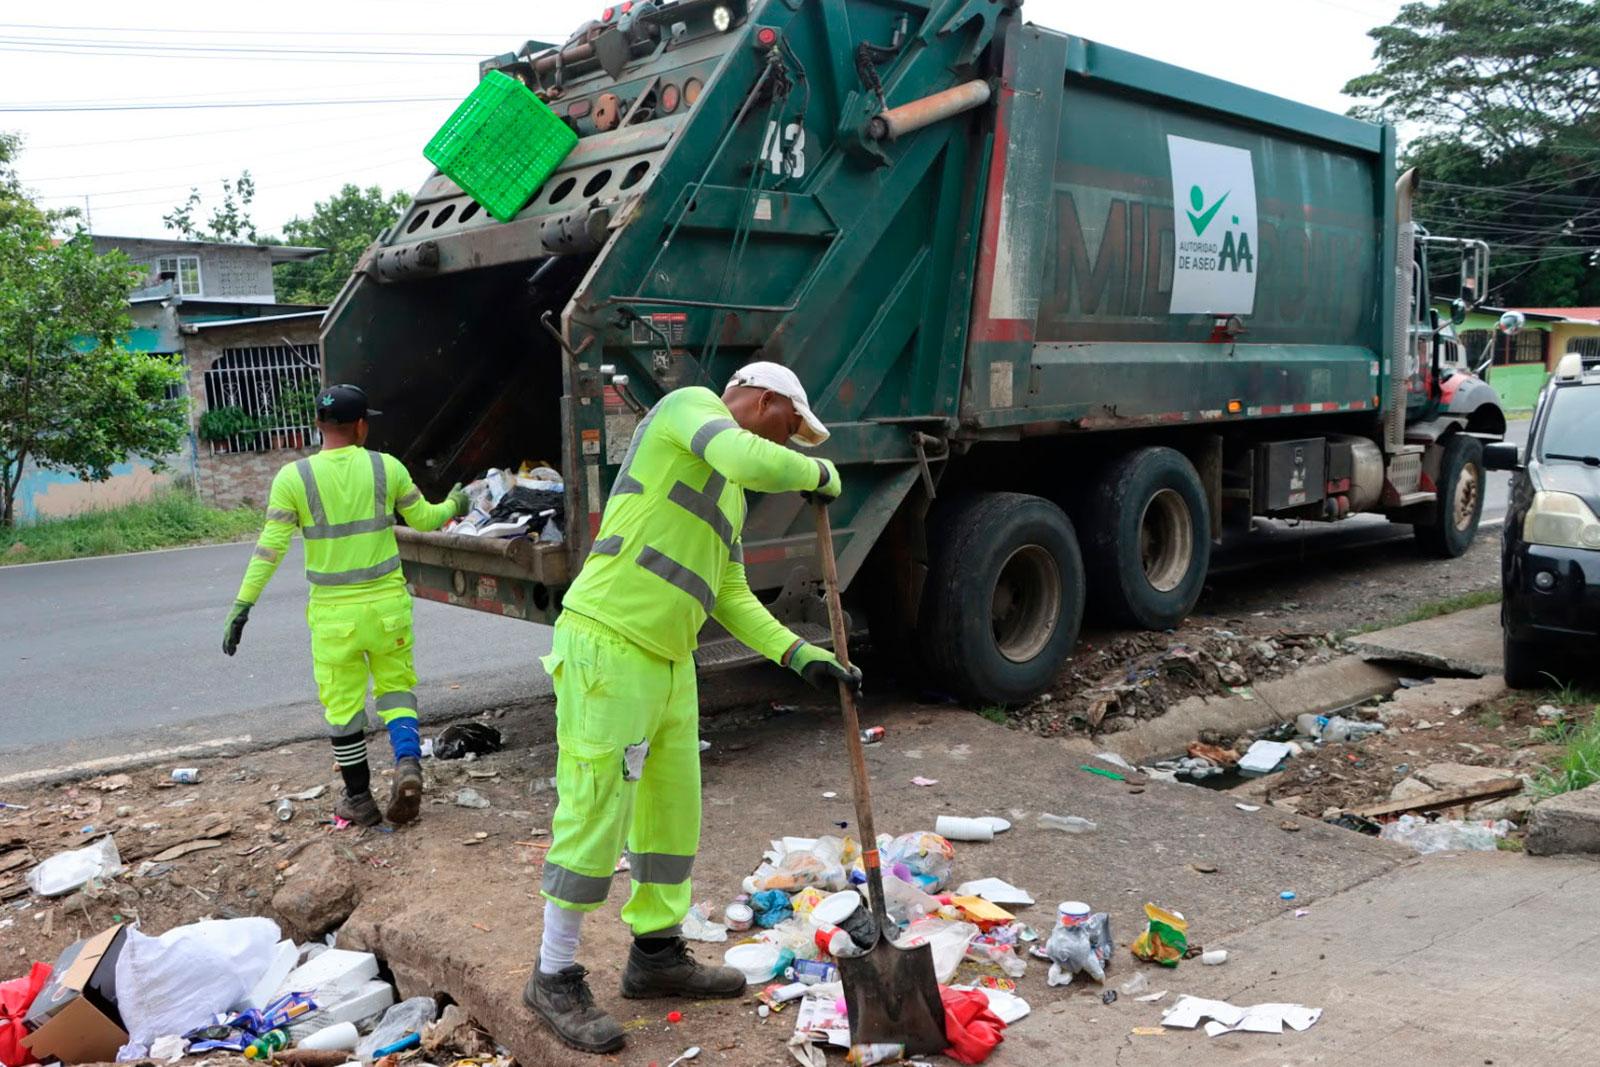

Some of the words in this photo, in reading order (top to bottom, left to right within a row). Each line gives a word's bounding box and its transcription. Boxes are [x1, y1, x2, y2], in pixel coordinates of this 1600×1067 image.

[760, 121, 805, 178] 43
[1179, 241, 1218, 253] AUTORIDAD
[1179, 255, 1191, 270] DE
[1192, 257, 1216, 271] ASEO
